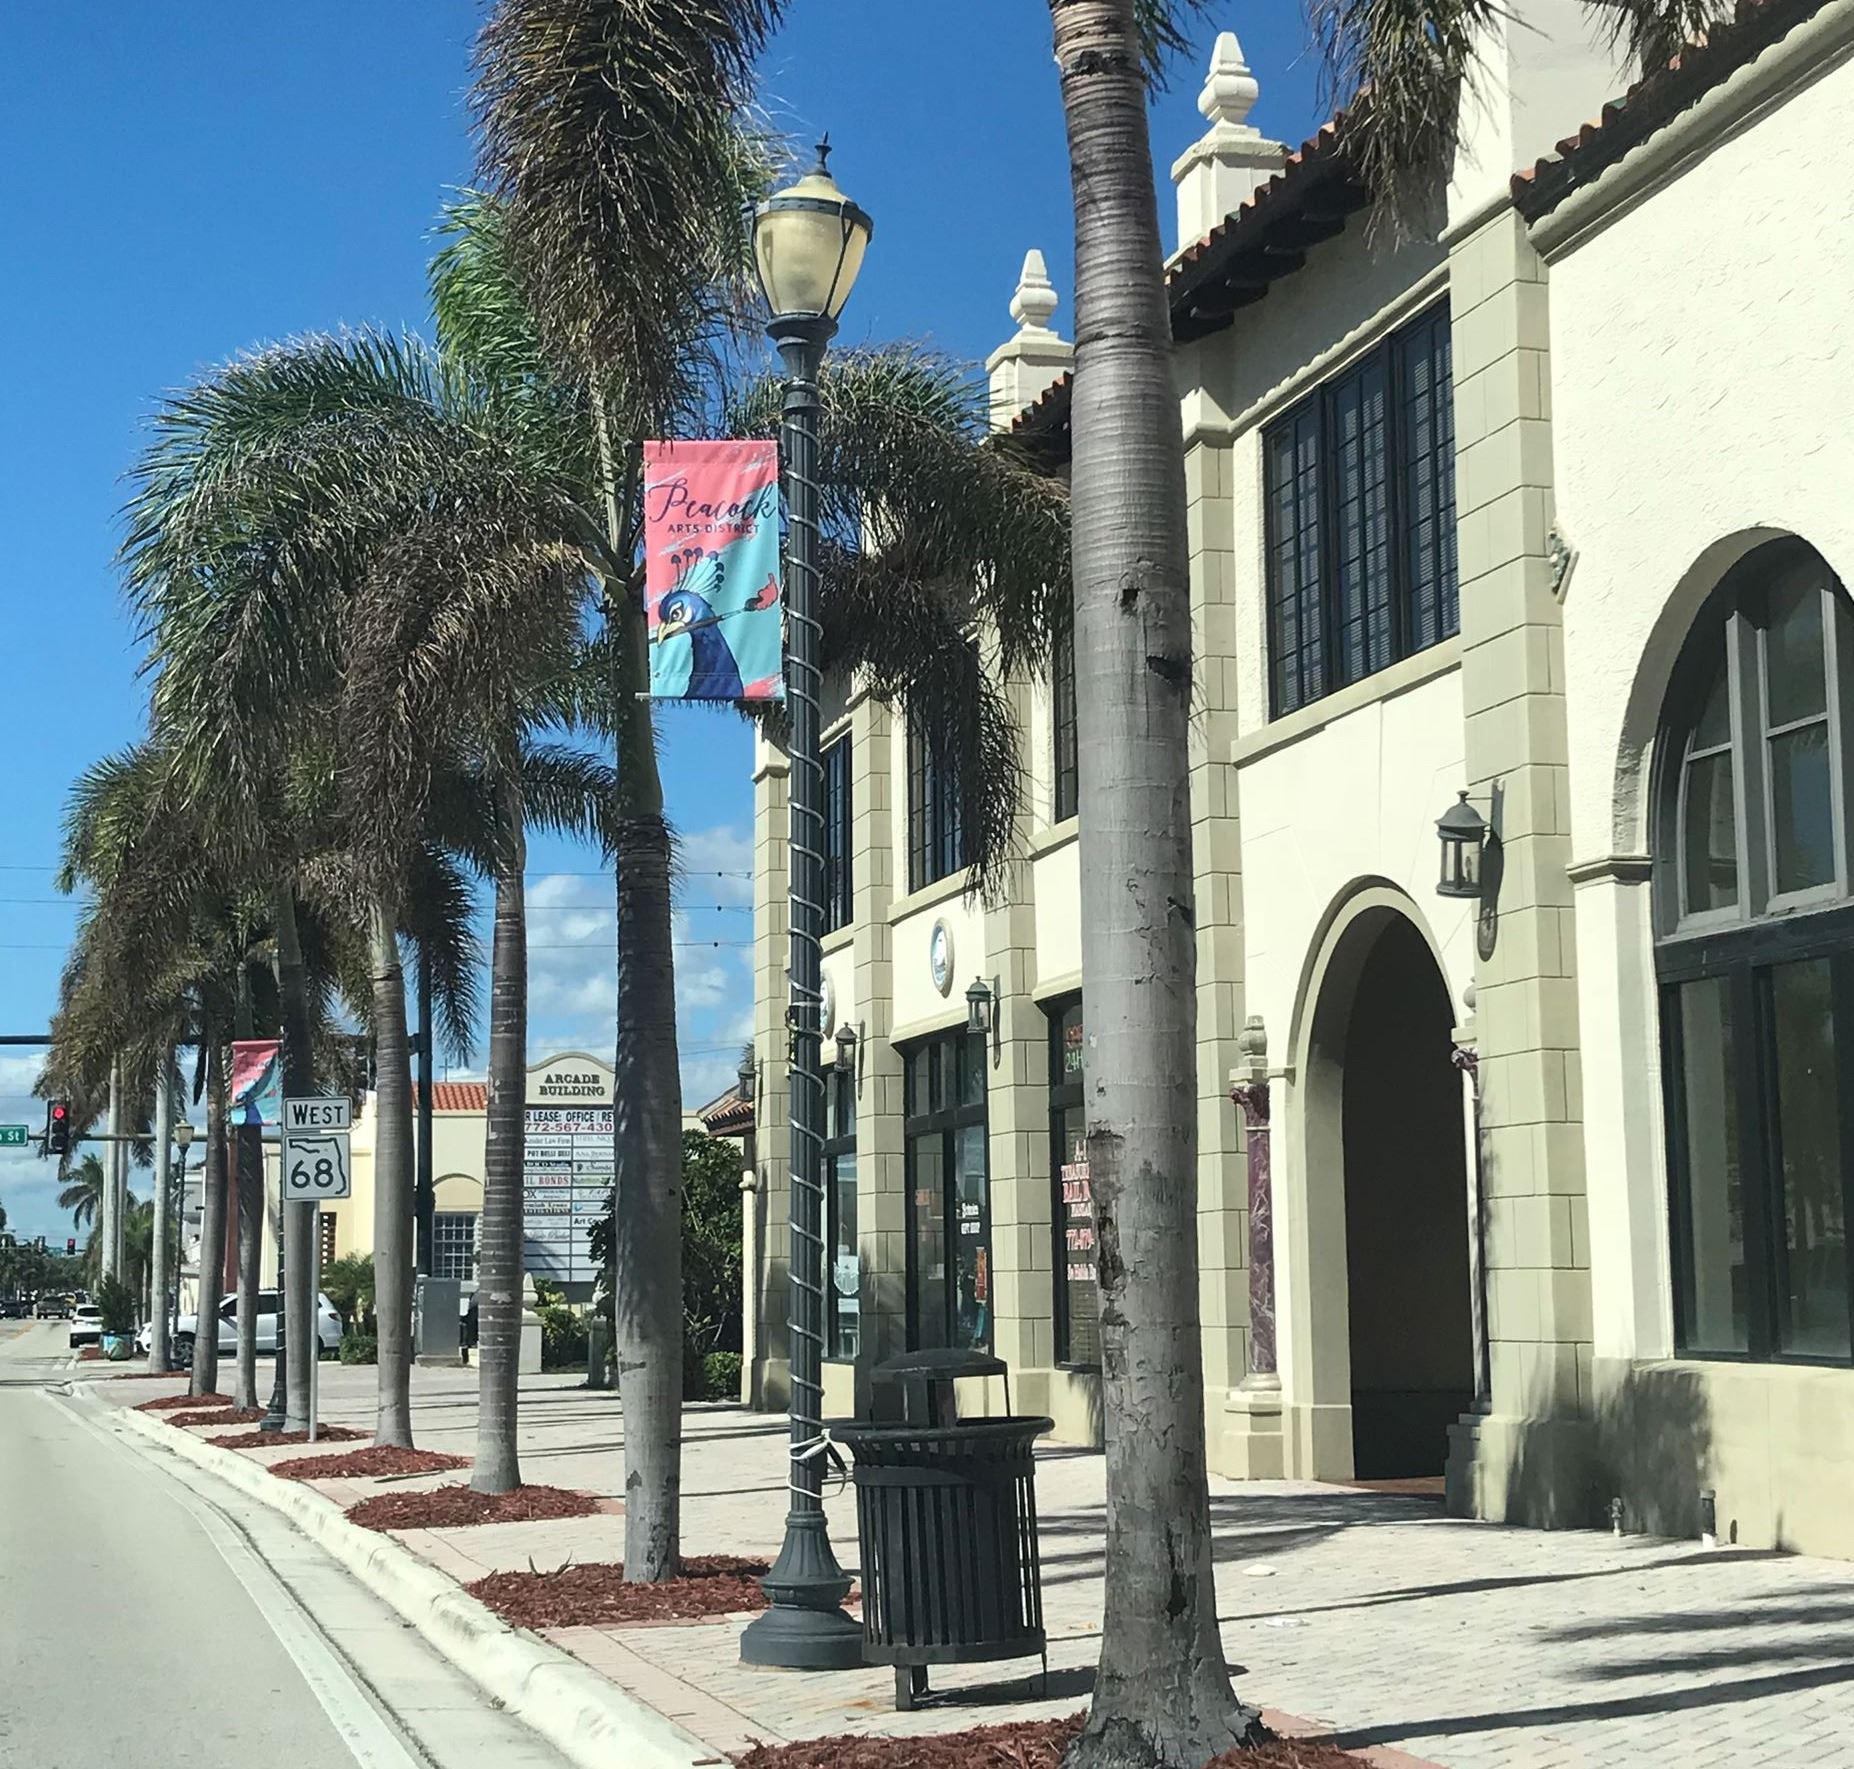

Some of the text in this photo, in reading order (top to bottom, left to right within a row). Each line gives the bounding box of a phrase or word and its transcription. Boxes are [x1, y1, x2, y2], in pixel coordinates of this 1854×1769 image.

[649, 478, 776, 522] Peacock
[668, 523, 759, 533] ARTS DISTRICT
[544, 1074, 600, 1084] ARCADE
[539, 1086, 605, 1096] BUILDING
[293, 1104, 343, 1125] WEST
[566, 1111, 594, 1122] OFFICE
[7, 1131, 20, 1141] St
[291, 1158, 334, 1188] 68
[539, 1176, 569, 1185] BONDS
[574, 1217, 586, 1225] Art
